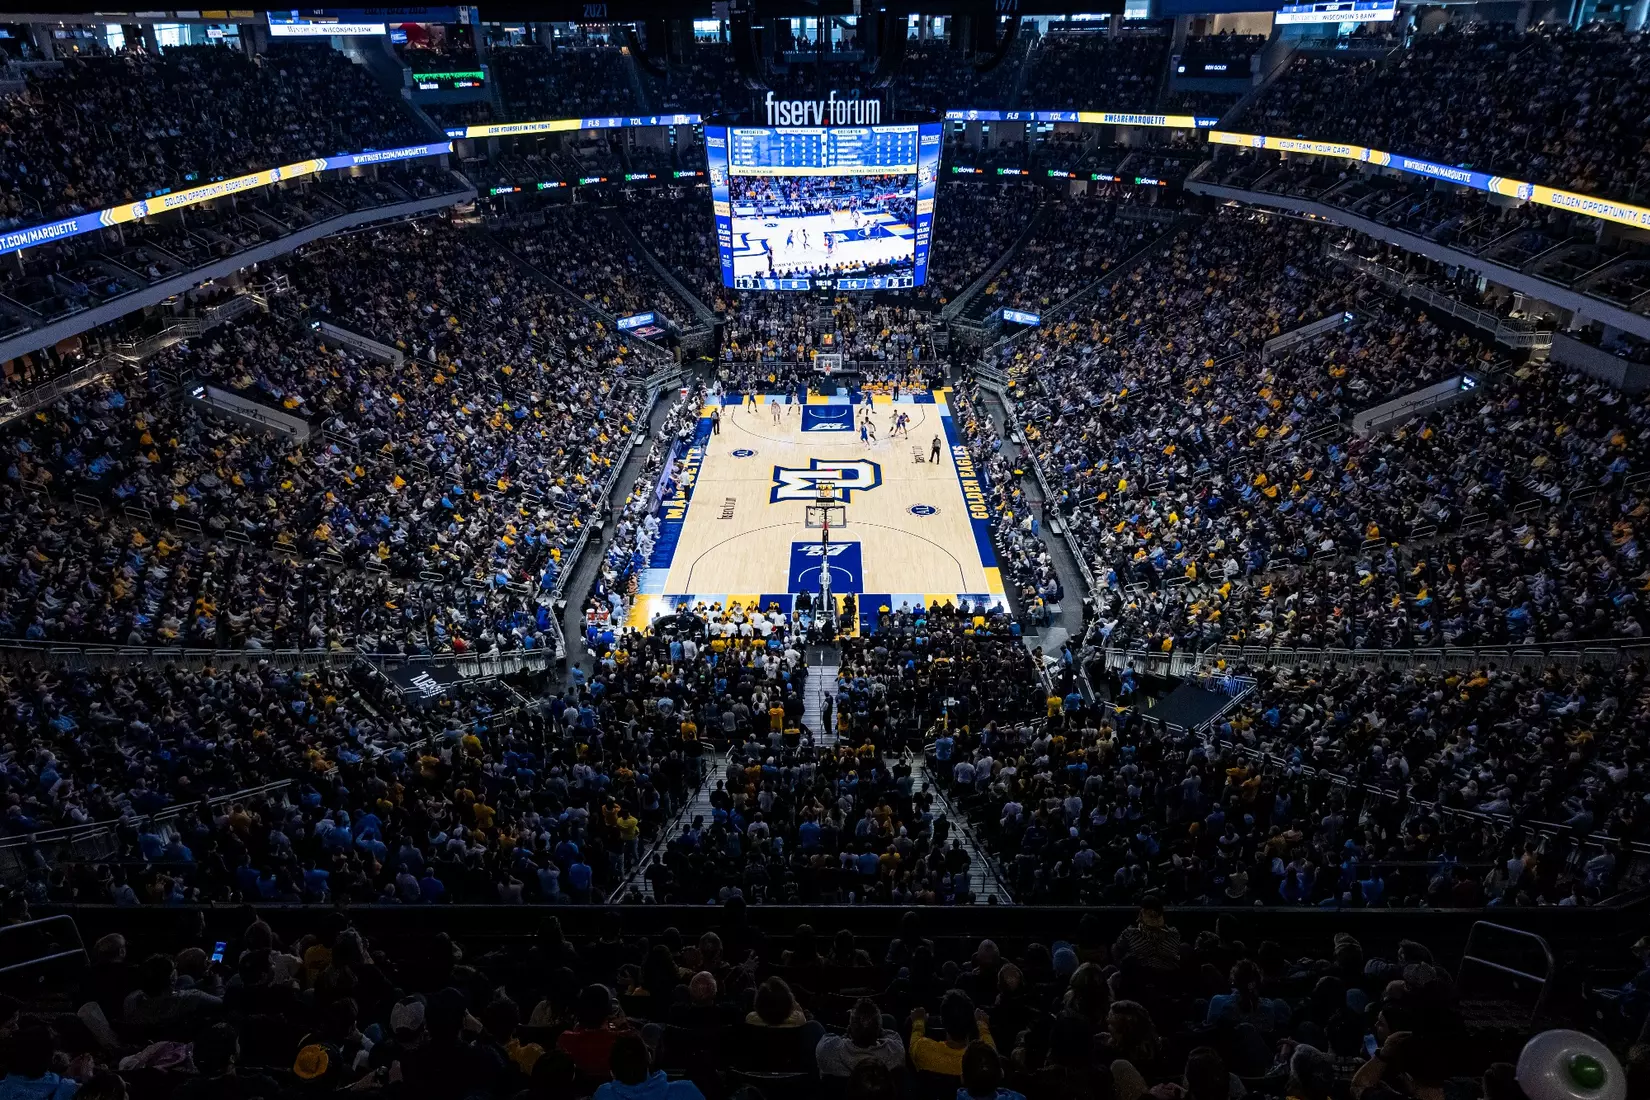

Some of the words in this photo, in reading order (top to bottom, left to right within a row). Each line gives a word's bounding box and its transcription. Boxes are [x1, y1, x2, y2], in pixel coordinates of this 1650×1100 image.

[1006, 112, 1019, 120] FLS
[500, 125, 522, 133] YOURSELF
[352, 147, 428, 163] WINTRUST.COM/MARQUETTE
[1279, 141, 1294, 149] YOUR
[1315, 145, 1331, 153] YOUR
[1333, 146, 1350, 155] CARD
[1403, 159, 1472, 183] WINTRUST.COM/MARQUETTE
[164, 194, 187, 207] GOLDEN
[225, 180, 241, 192] SCORE
[1552, 193, 1580, 207] GOLDEN
[952, 445, 976, 478] EAGLES
[961, 480, 990, 519] GOLDEN
